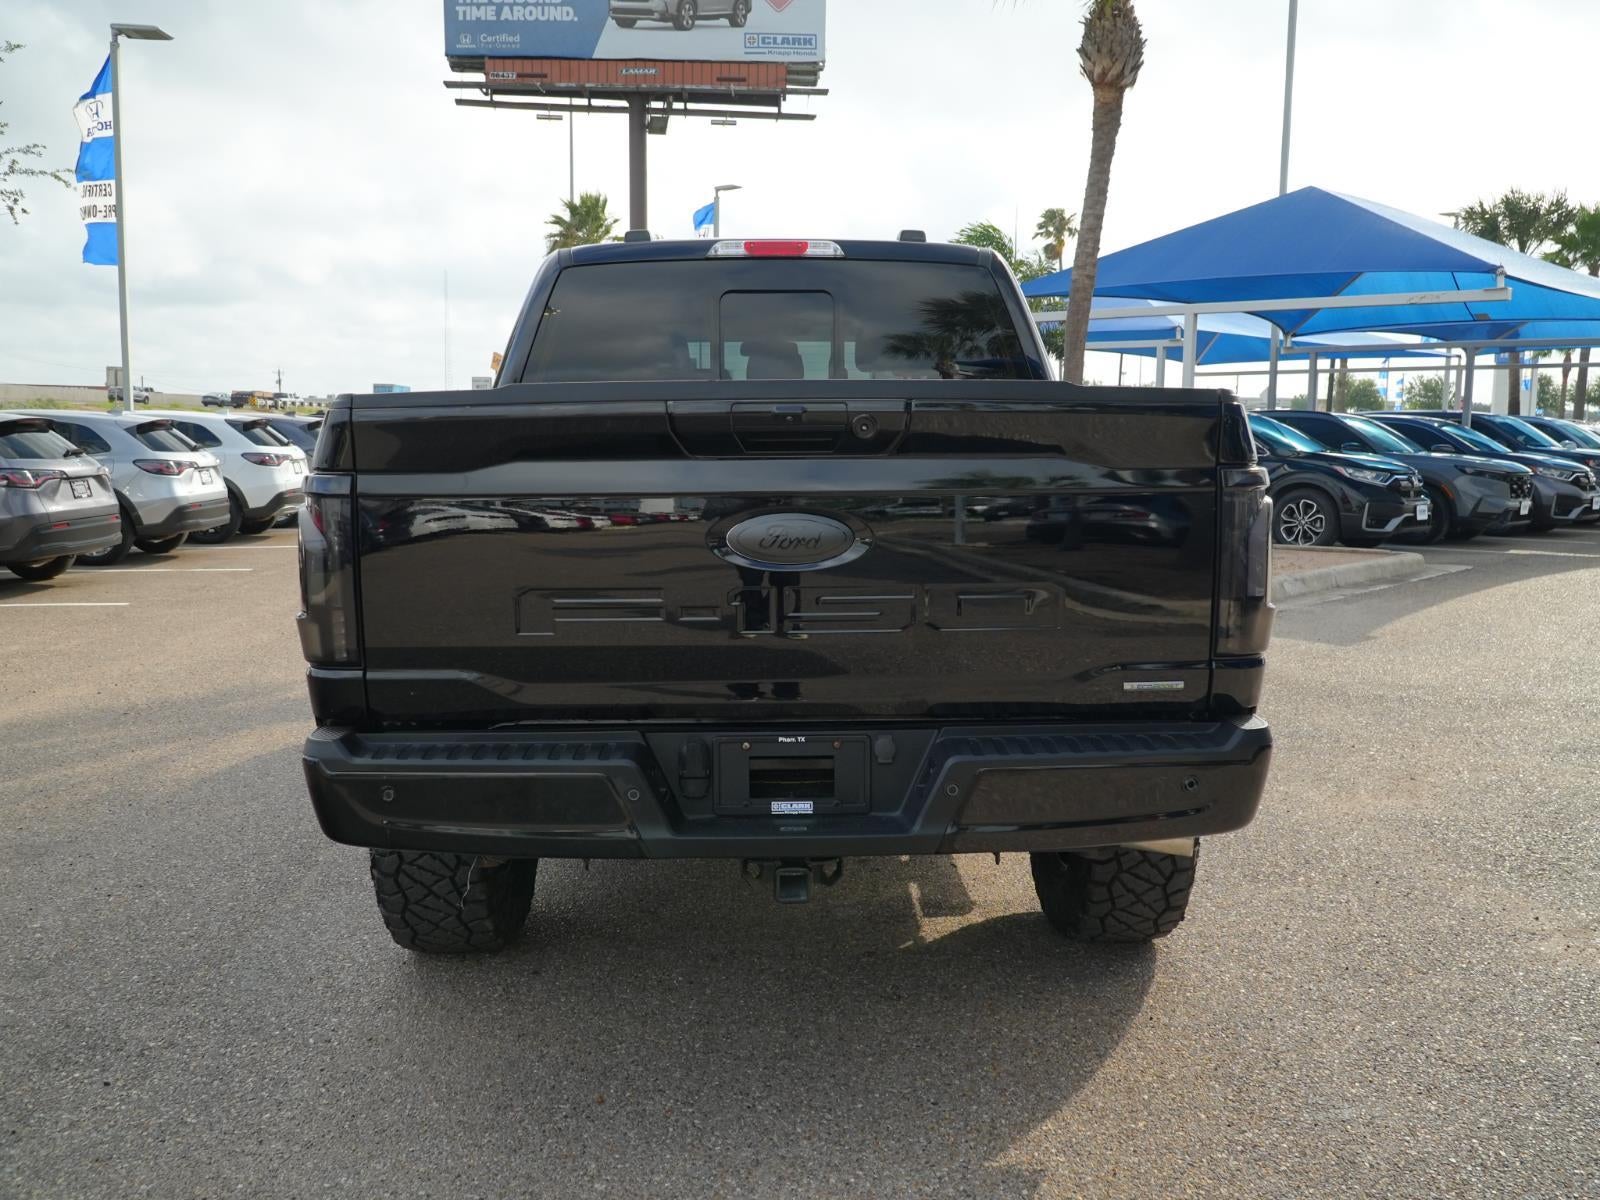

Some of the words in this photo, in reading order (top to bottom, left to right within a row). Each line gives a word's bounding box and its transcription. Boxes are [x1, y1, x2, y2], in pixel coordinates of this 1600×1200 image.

[455, 6, 496, 21] TIME
[500, 6, 578, 21] AROUND.
[480, 32, 521, 43] Certified
[761, 36, 813, 46] CLARK
[759, 525, 824, 550] Ford
[514, 584, 1066, 637] F-150
